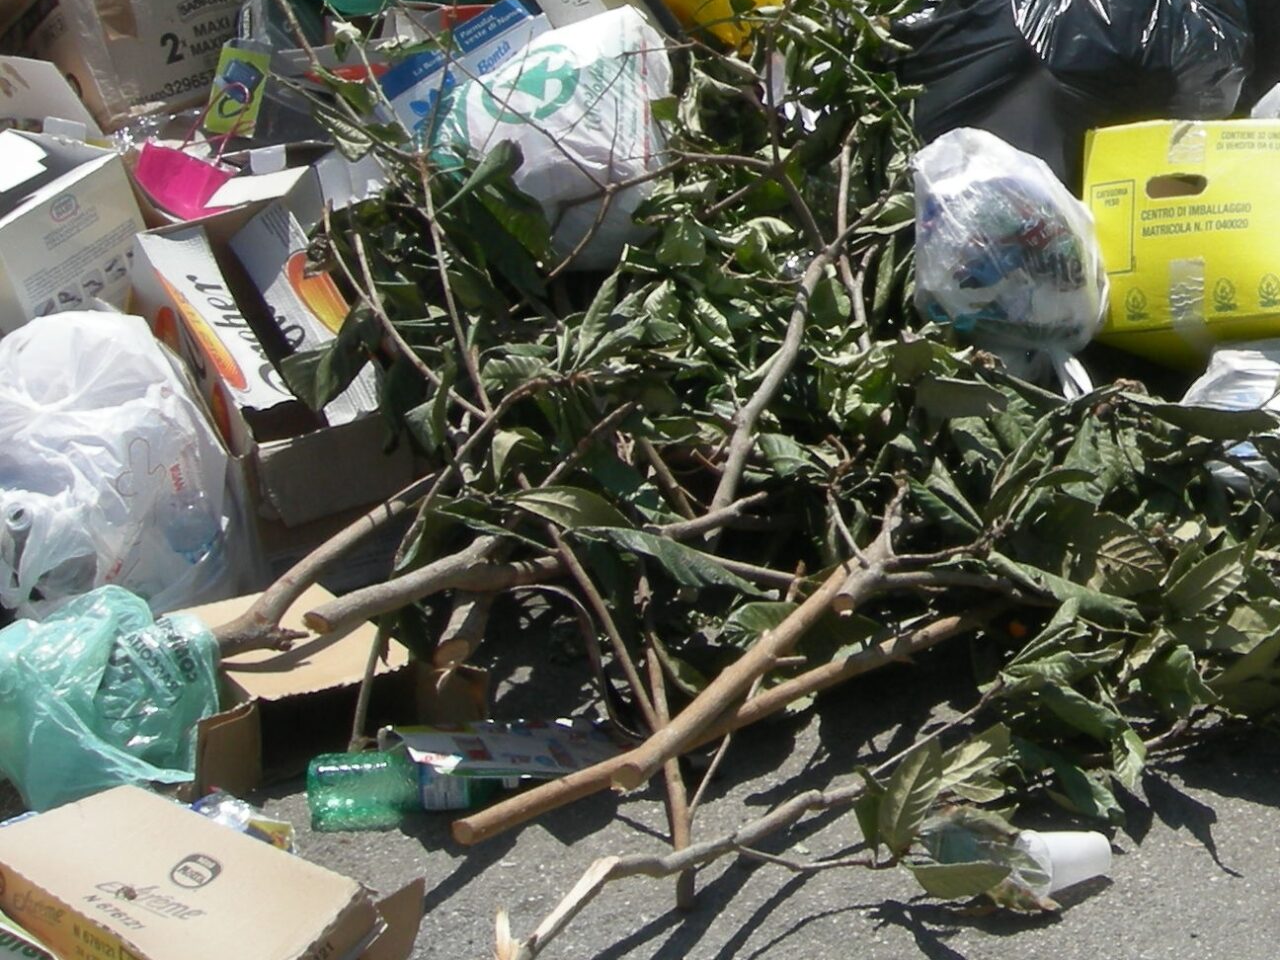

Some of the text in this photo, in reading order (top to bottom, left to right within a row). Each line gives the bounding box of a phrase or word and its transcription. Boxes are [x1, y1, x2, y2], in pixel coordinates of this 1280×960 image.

[193, 17, 230, 37] MAXI
[1141, 202, 1252, 221] CENTRO DI IMBALLAGGIO
[1142, 221, 1191, 238] MATRICOLA
[1204, 220, 1213, 231] IT
